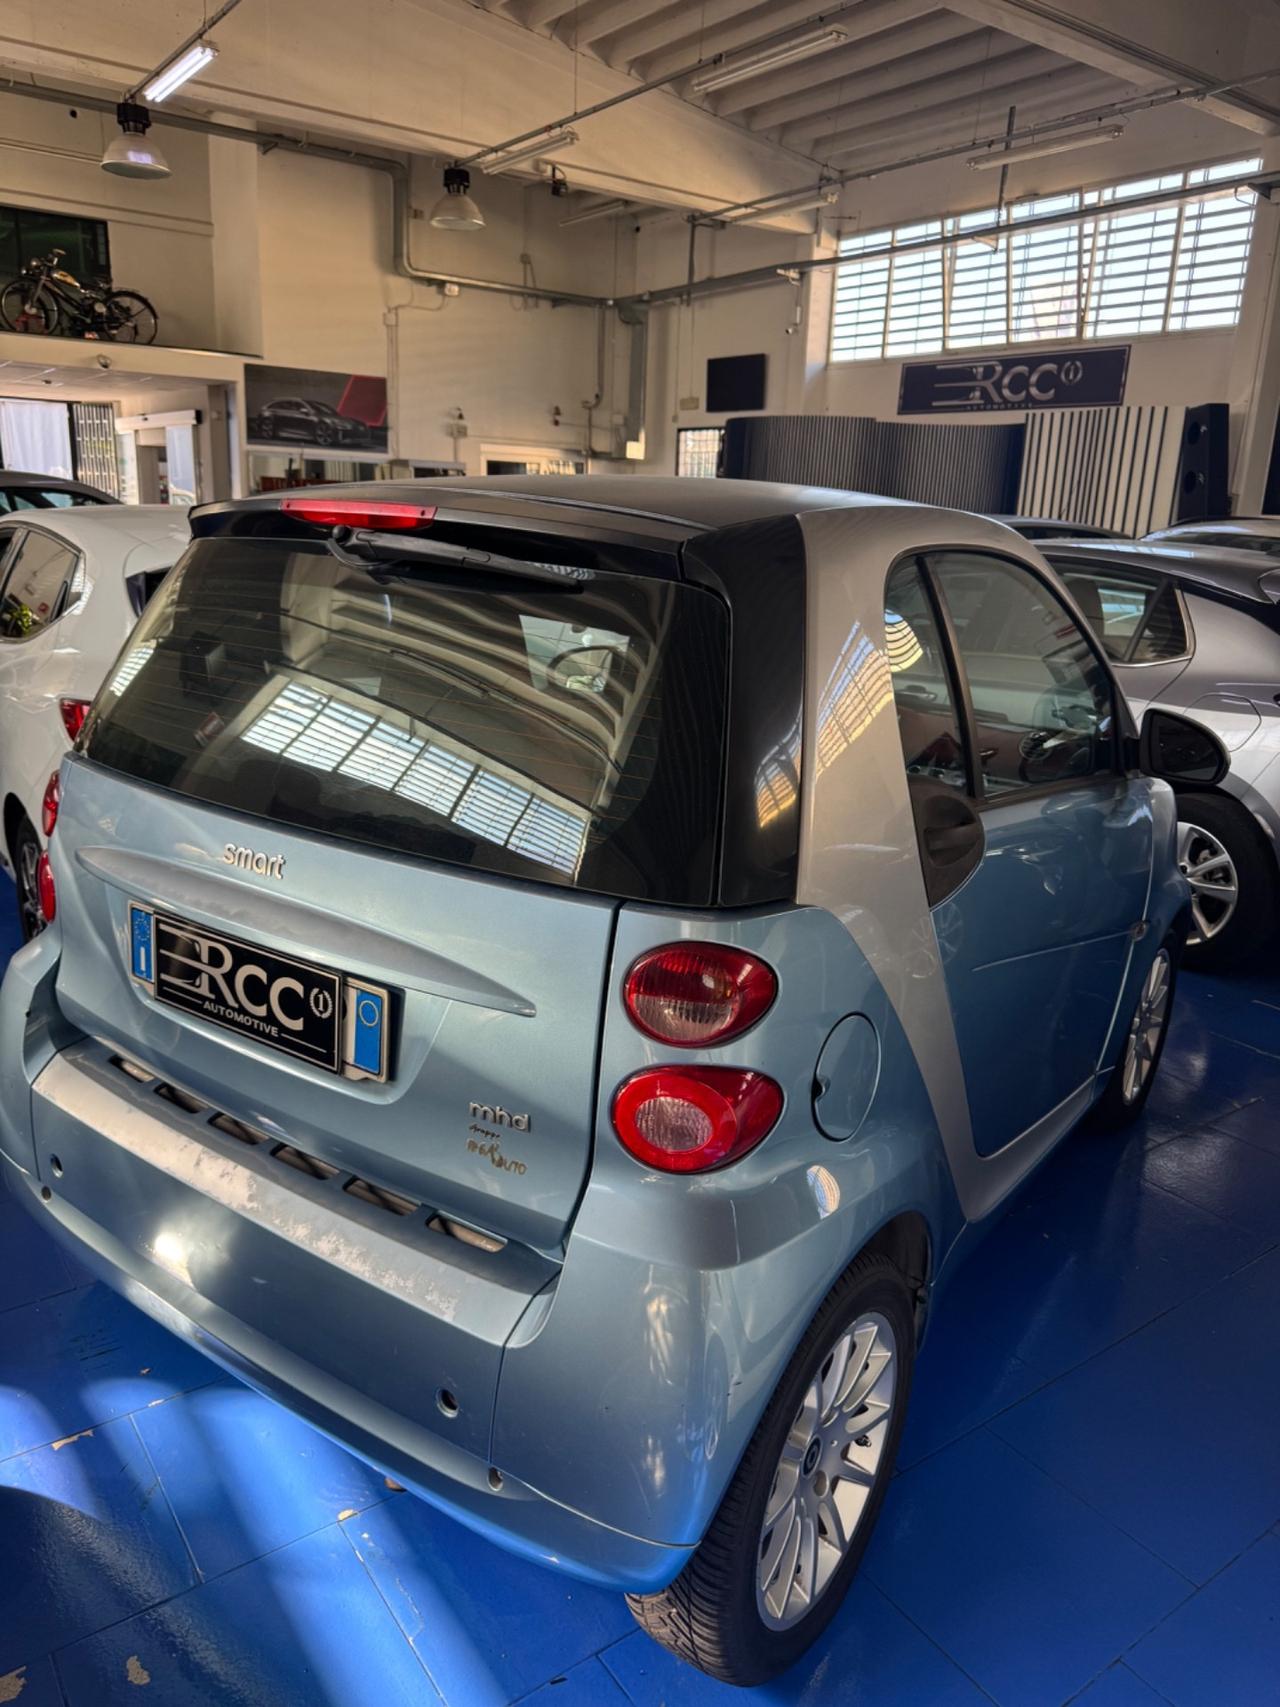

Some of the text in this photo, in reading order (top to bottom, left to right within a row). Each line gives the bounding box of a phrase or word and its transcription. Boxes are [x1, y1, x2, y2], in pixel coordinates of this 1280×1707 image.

[966, 361, 1058, 403] RCC
[222, 843, 286, 879] smart
[190, 933, 304, 1032] RCC
[203, 1001, 279, 1037] AUTOMOTIVE
[469, 1102, 531, 1133] mhd
